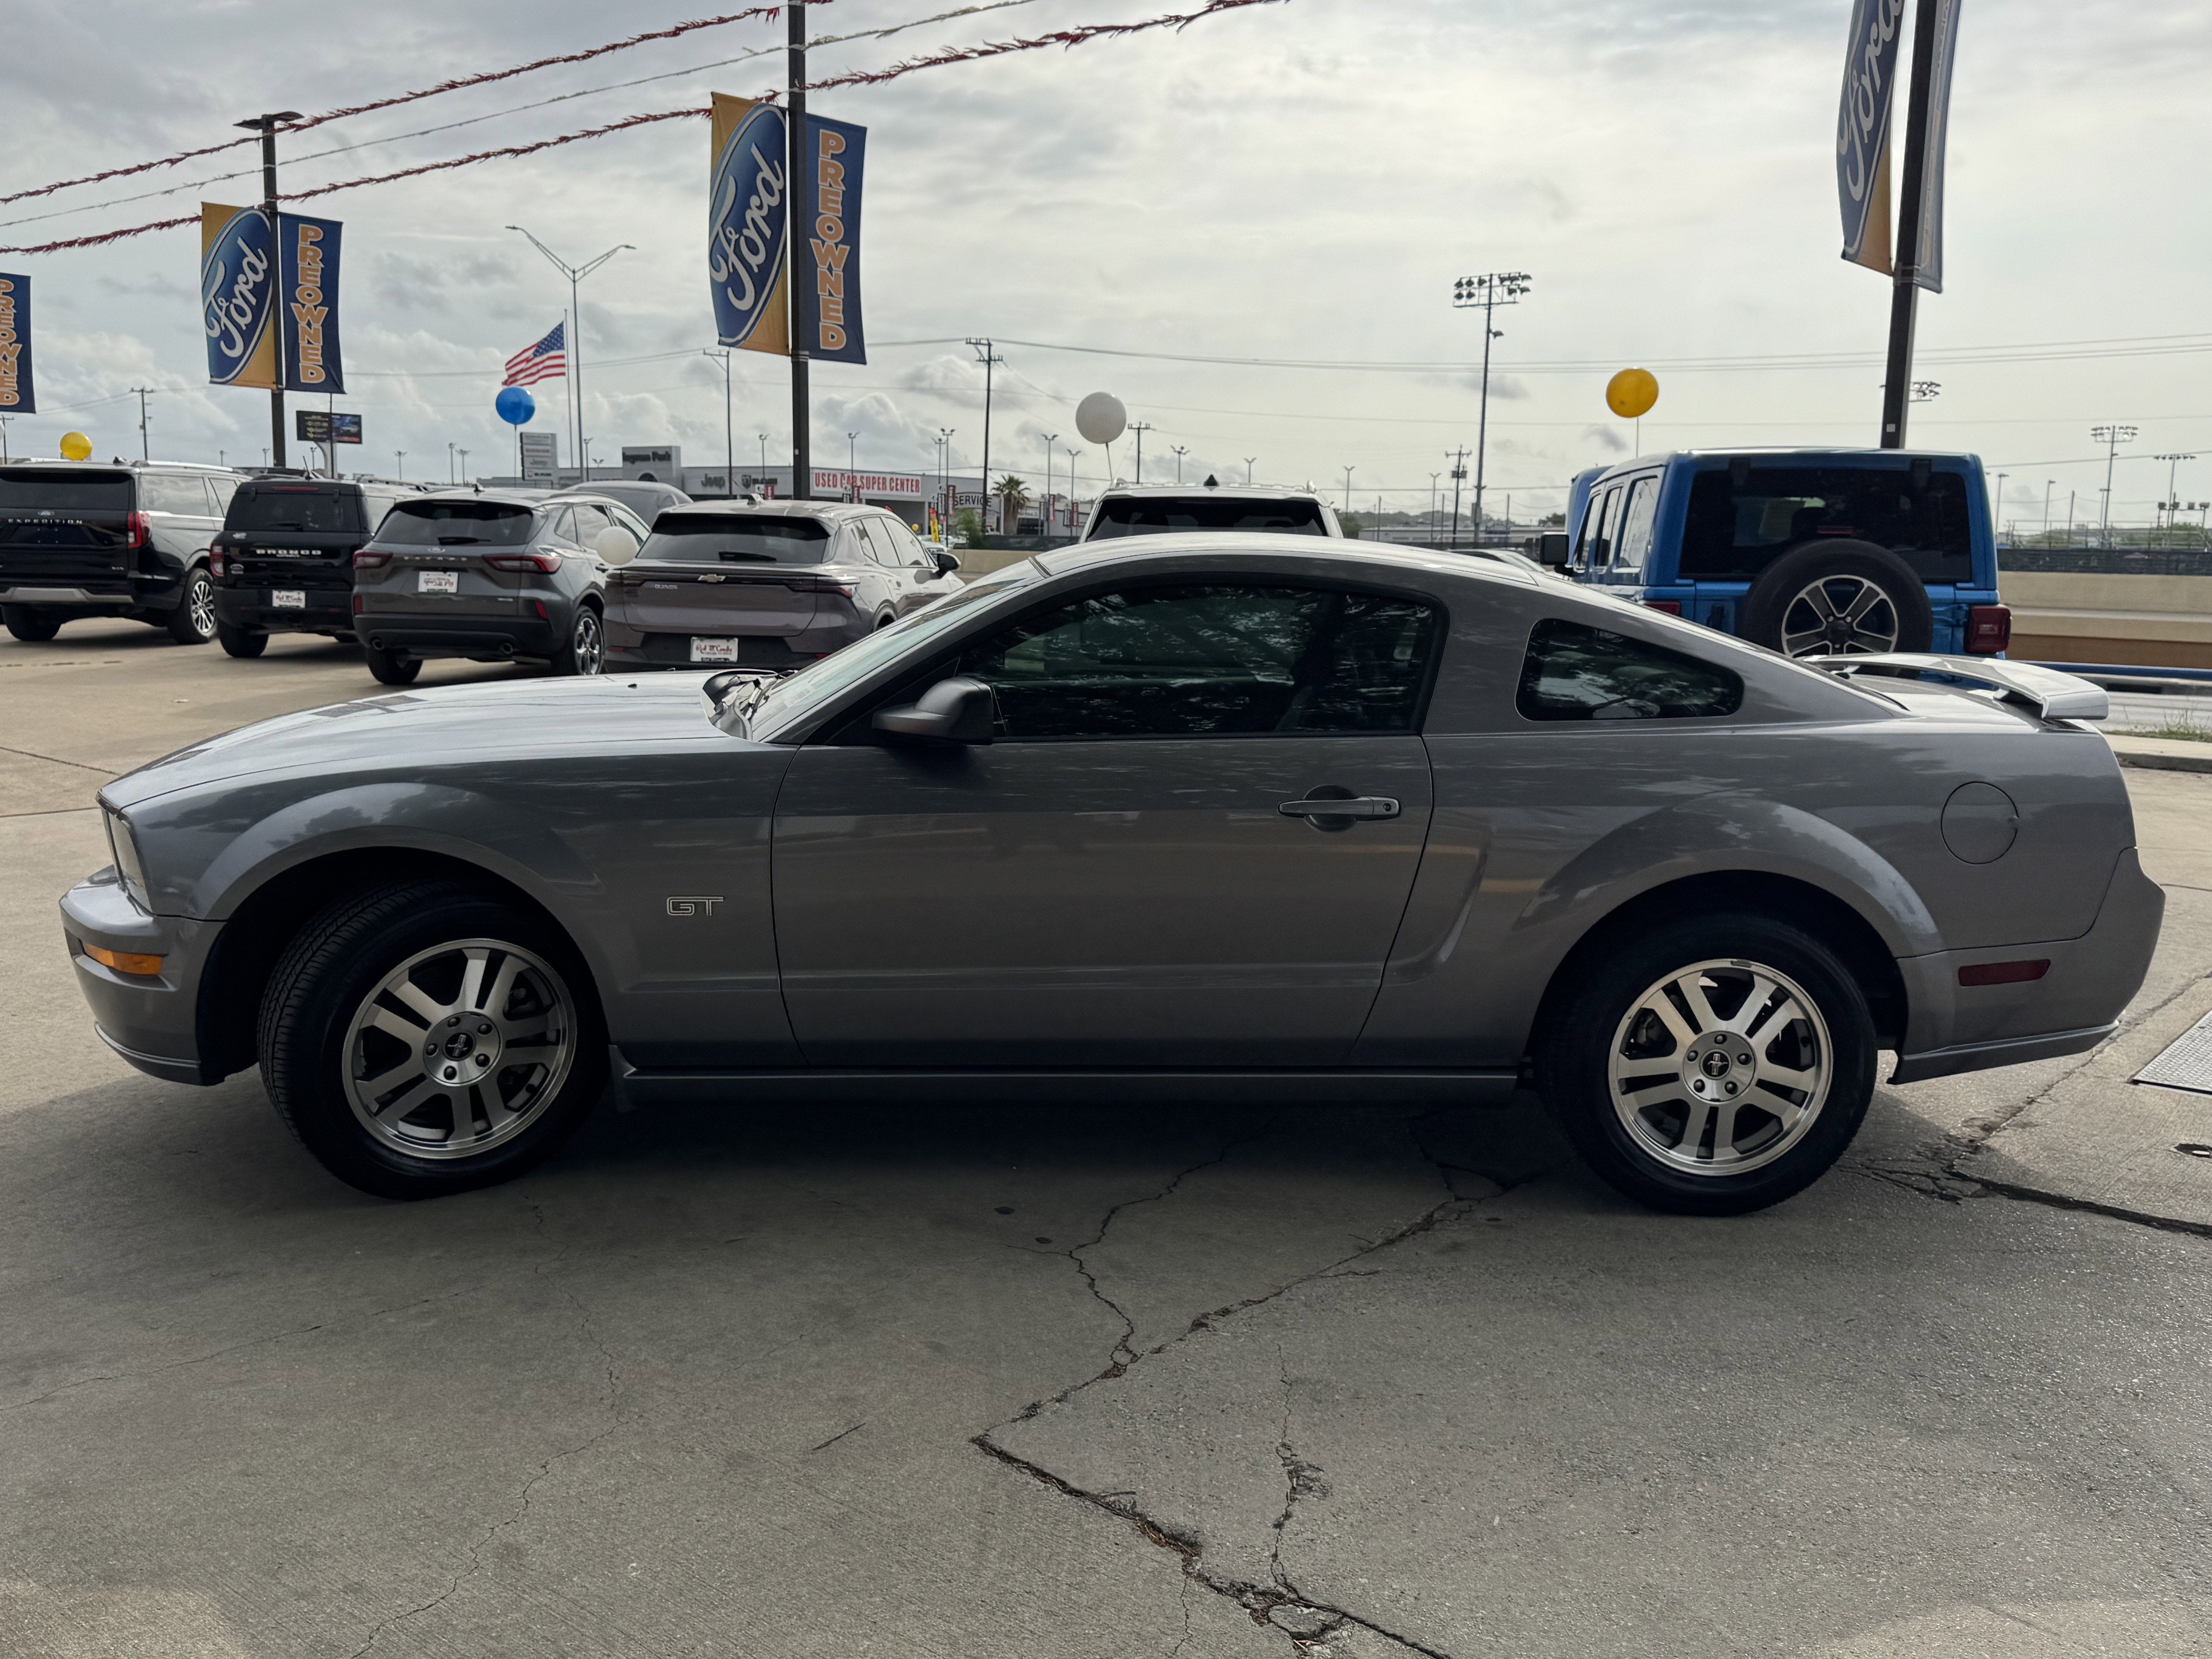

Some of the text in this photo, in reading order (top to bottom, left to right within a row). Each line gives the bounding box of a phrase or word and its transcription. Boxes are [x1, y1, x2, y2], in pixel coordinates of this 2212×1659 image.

[709, 143, 785, 311] Ford
[809, 129, 850, 350] PREOWNED
[204, 236, 268, 357] Ford
[290, 223, 329, 384] PREOWNED
[815, 472, 838, 488] USED
[860, 475, 887, 491] SUPER
[889, 477, 921, 493] CENTER
[954, 495, 993, 507] SERVICE
[666, 896, 724, 916] GT
